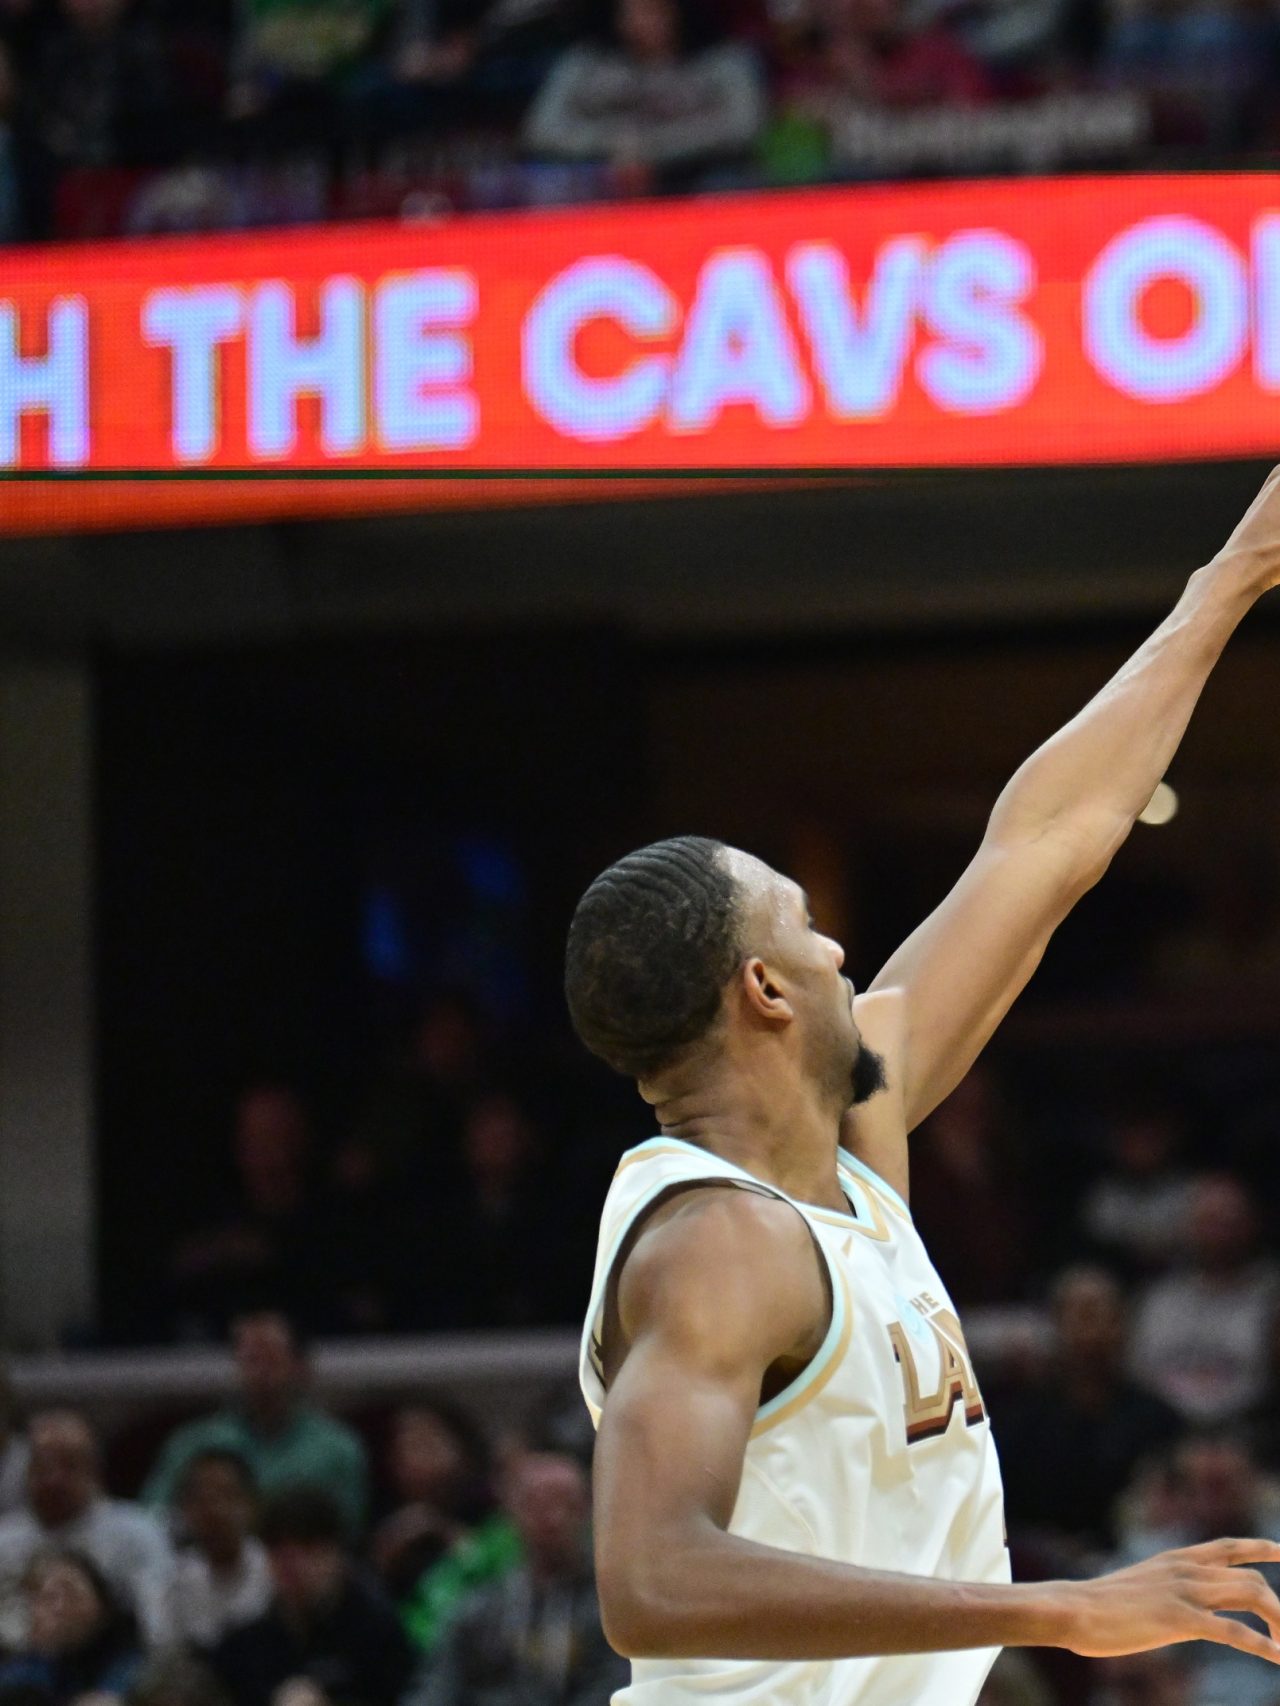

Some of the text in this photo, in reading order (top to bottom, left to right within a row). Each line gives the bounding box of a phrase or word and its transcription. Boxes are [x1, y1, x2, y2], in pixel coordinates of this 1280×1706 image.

[141, 268, 478, 462] THE
[520, 229, 1042, 441] CAVS
[909, 1291, 940, 1316] HE
